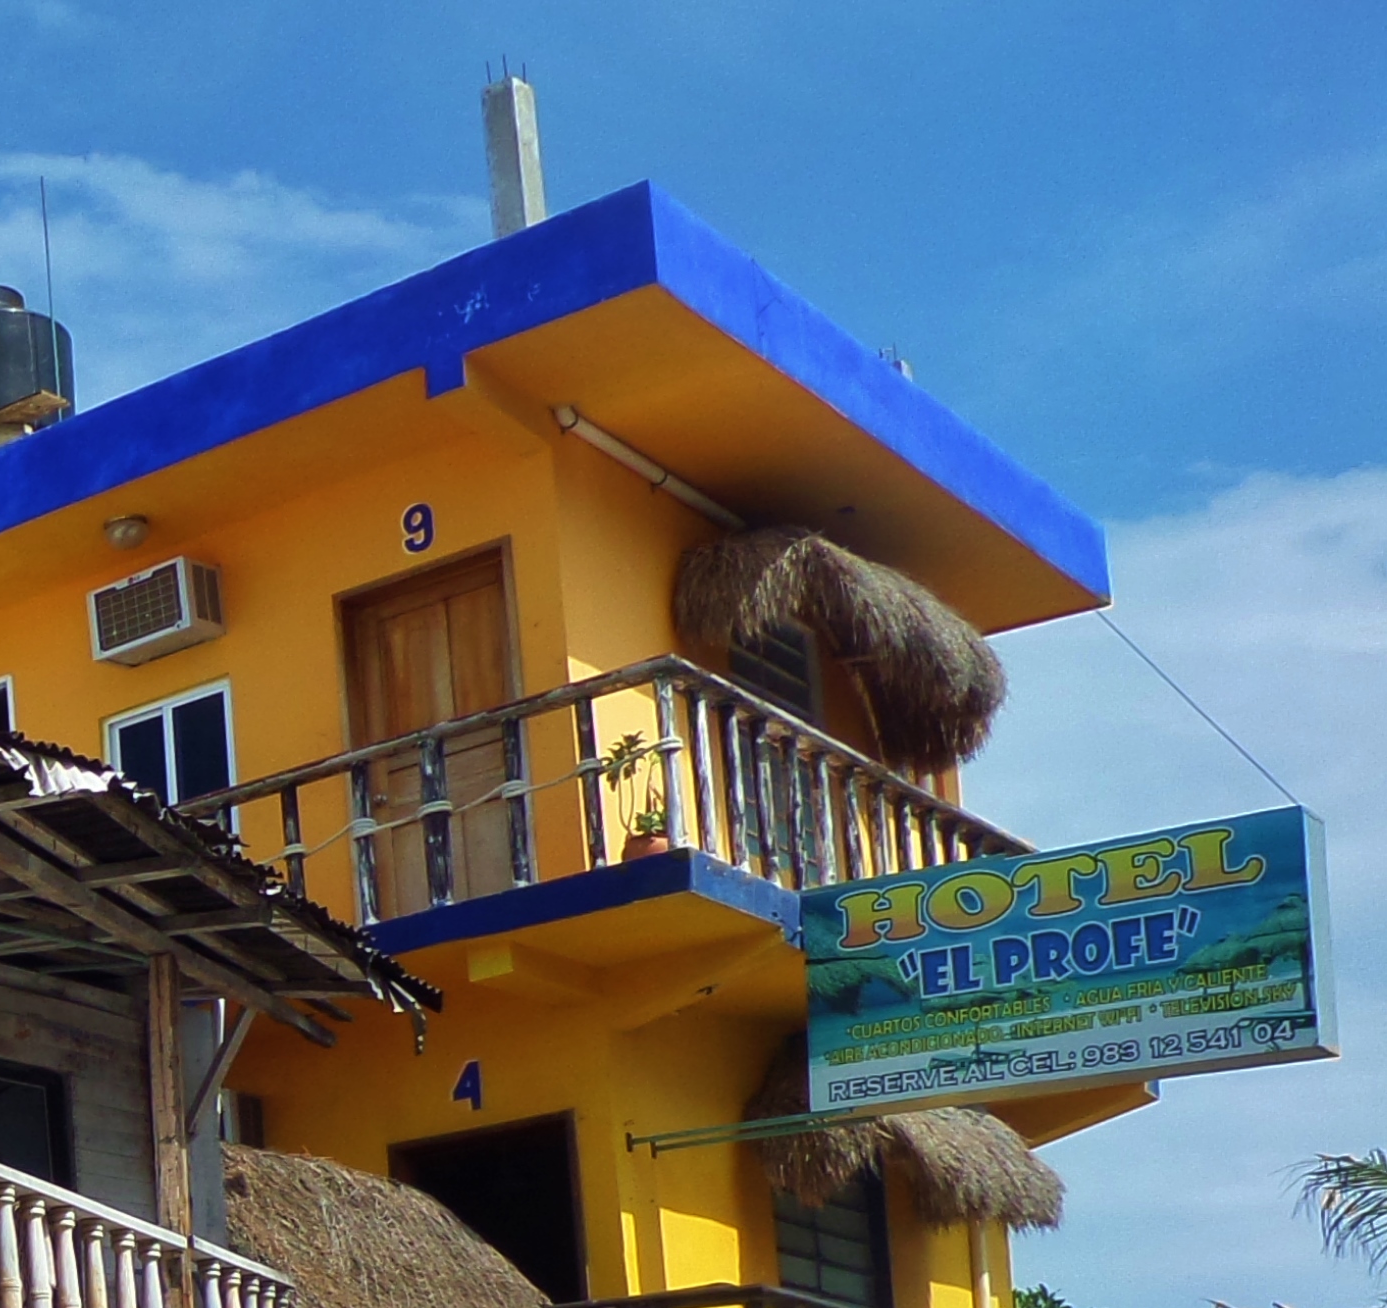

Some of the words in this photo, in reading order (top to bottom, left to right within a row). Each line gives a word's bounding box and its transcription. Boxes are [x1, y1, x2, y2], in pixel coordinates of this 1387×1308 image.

[403, 503, 434, 554] 9
[835, 827, 1265, 950] HOTEL
[829, 1047, 865, 1066] AIRE
[865, 1026, 1005, 1061] ACONDICIONADO
[1016, 1012, 1096, 1040] INTERNET
[1160, 988, 1259, 1018] TELEVISION
[852, 1016, 921, 1041] CUARTOS
[925, 995, 1051, 1030] CONFORTABLES
[1076, 985, 1126, 1006] AGUA
[1127, 979, 1164, 1000] FRIA
[1168, 977, 1182, 993] Y
[1183, 964, 1268, 991] CALIENTE
[452, 1060, 483, 1111] 4
[828, 1065, 958, 1102] RESERVE
[962, 1060, 1006, 1084] AL
[1008, 1051, 1077, 1078] CEL:
[1081, 1040, 1140, 1068] 983
[1149, 1034, 1183, 1058] 12
[1186, 1024, 1243, 1053] 541
[1252, 1019, 1296, 1044] 04
